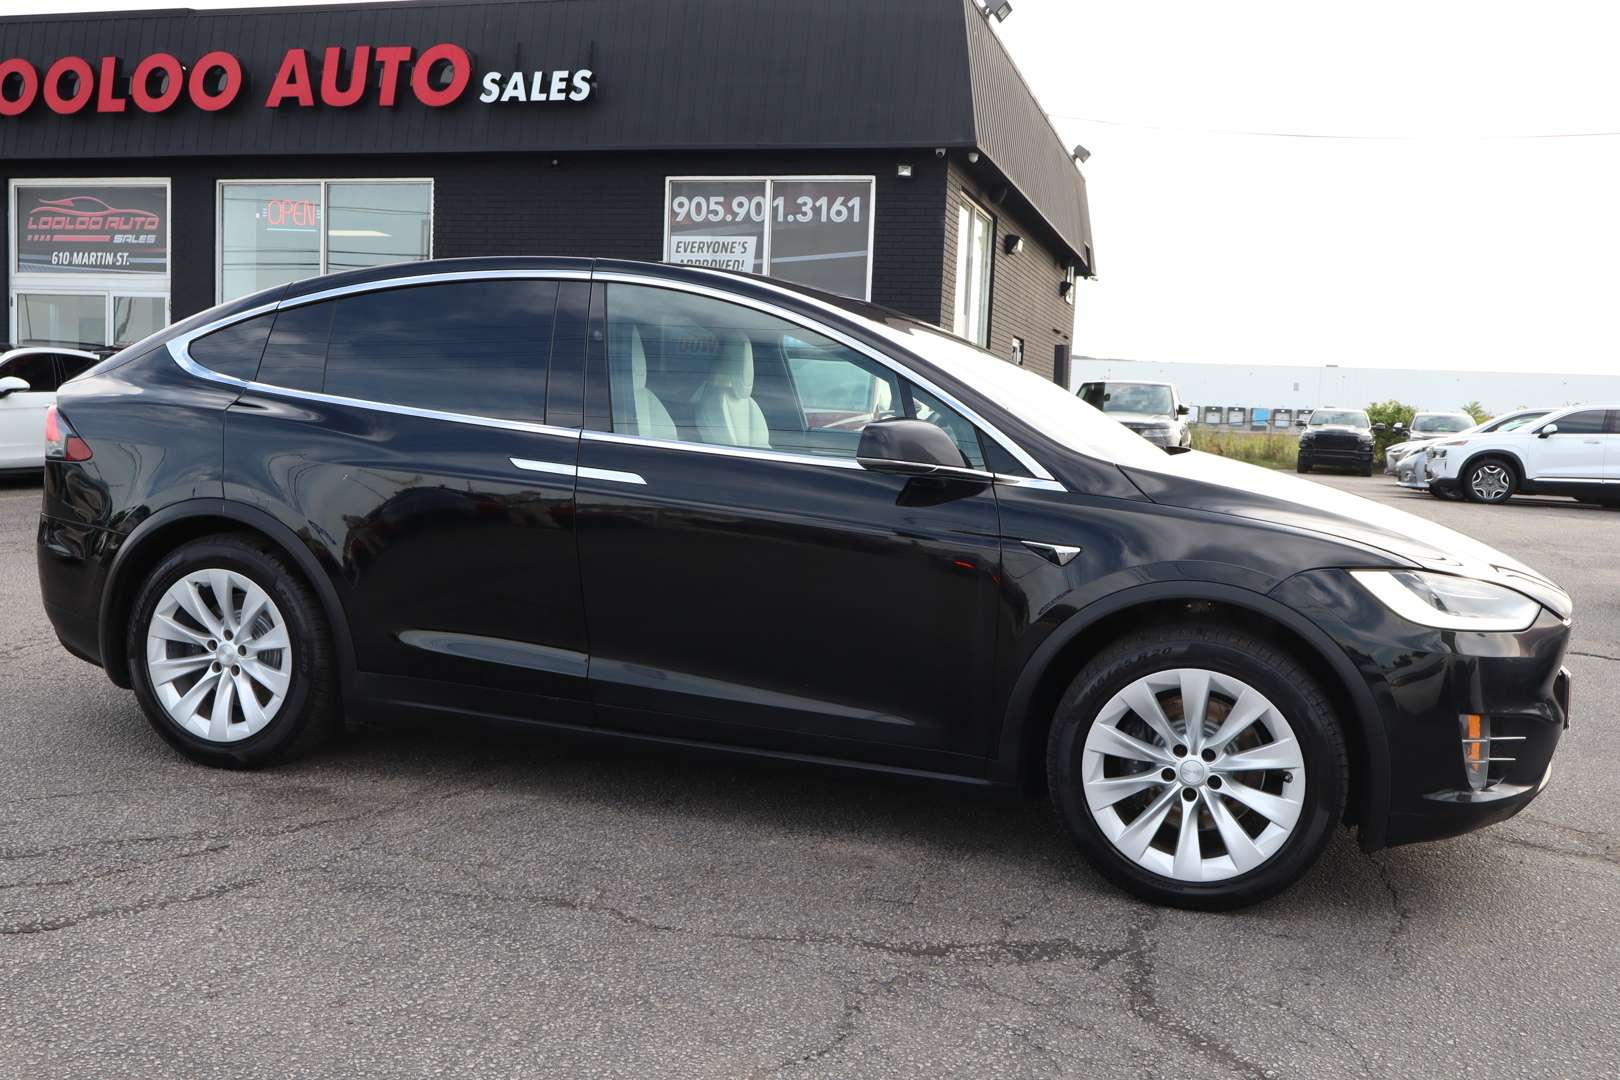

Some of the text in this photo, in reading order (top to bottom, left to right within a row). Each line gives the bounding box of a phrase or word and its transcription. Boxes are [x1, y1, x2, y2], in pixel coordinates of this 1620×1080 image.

[265, 43, 472, 108] AUTO
[479, 69, 593, 103] SALES
[267, 199, 316, 226] OPEN
[672, 195, 861, 223] 905.901.3161
[27, 216, 160, 230] LOOLOO AUTO
[113, 234, 157, 244] SALES
[675, 240, 748, 254] EVERYONE'S
[51, 251, 130, 265] 610 MARTIN ST.
